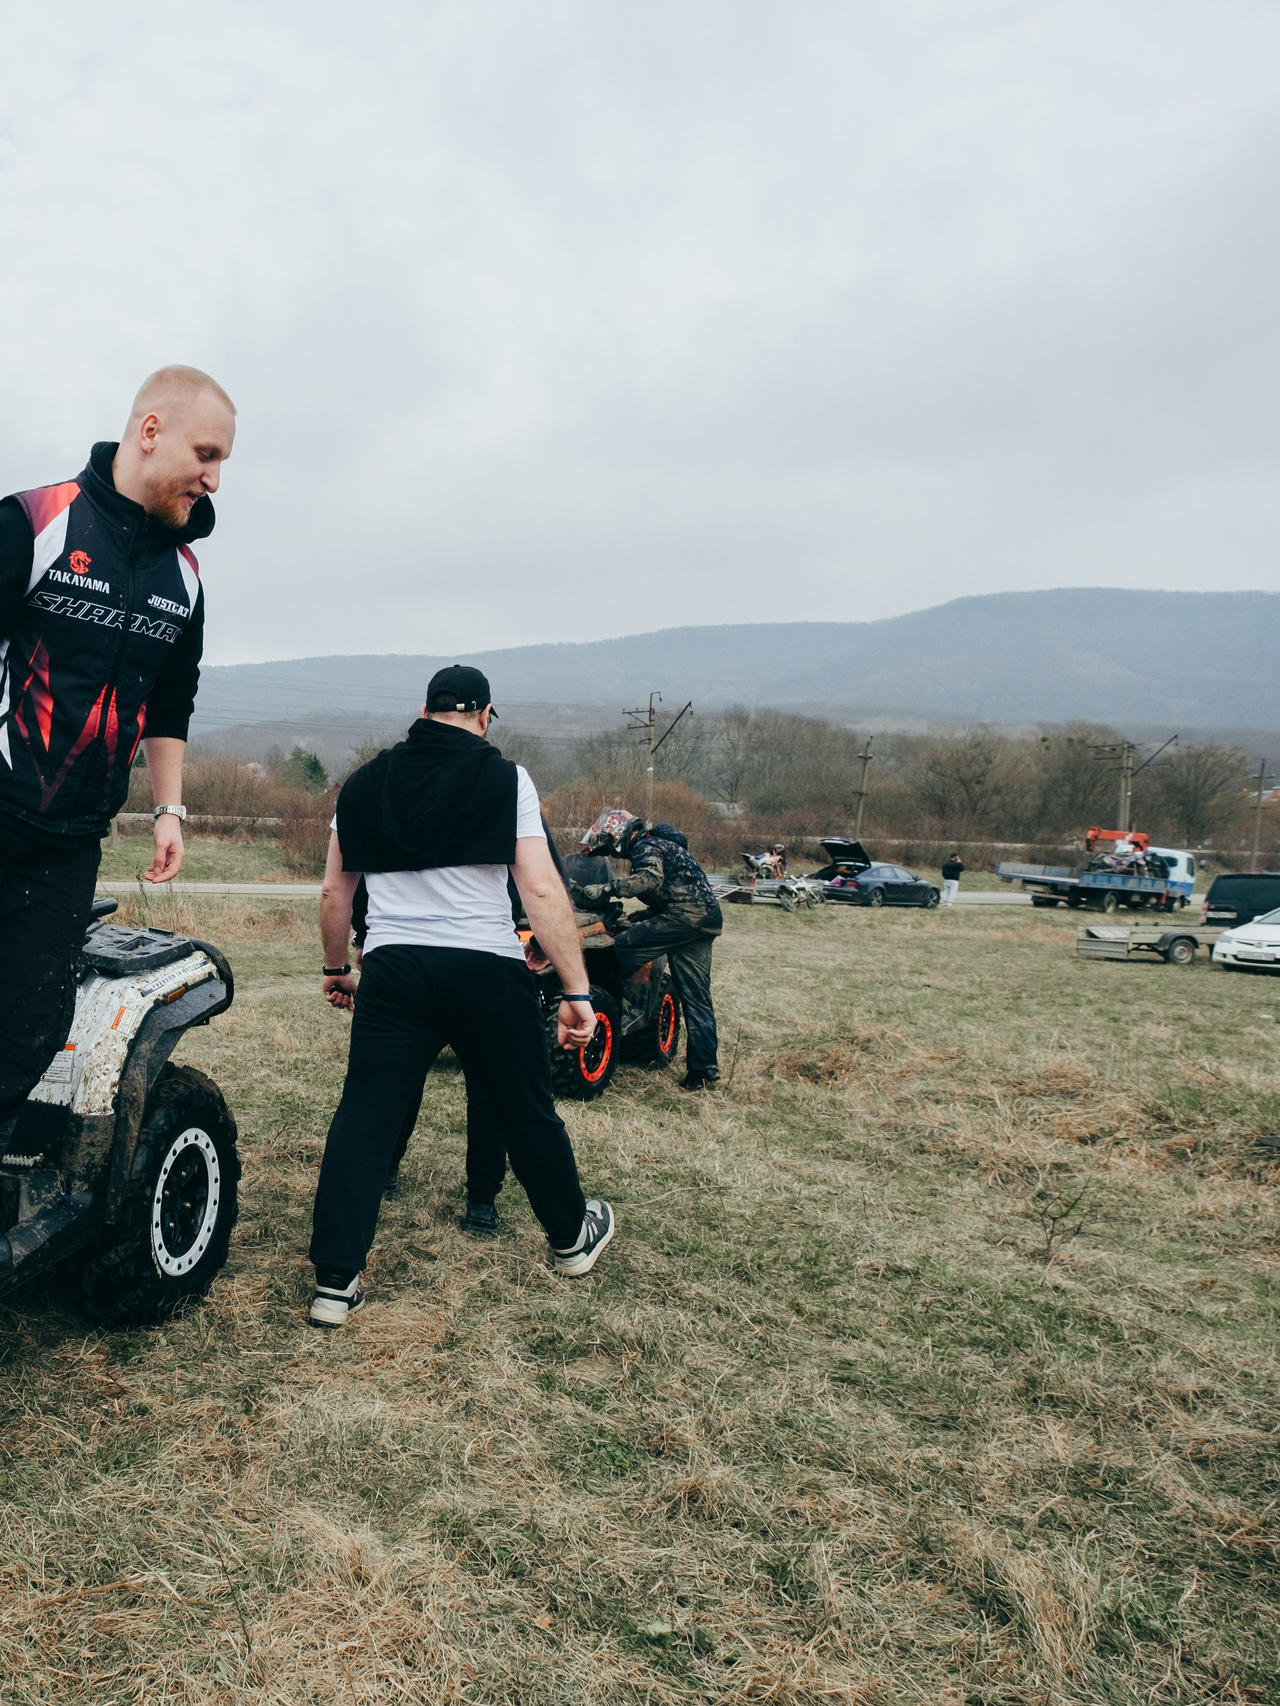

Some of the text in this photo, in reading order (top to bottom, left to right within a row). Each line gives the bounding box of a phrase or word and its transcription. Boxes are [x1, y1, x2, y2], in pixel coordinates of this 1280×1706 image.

[48, 568, 110, 594] TAKAYAMA
[27, 591, 183, 643] SHARMA
[147, 594, 190, 618] JUSTCAT
